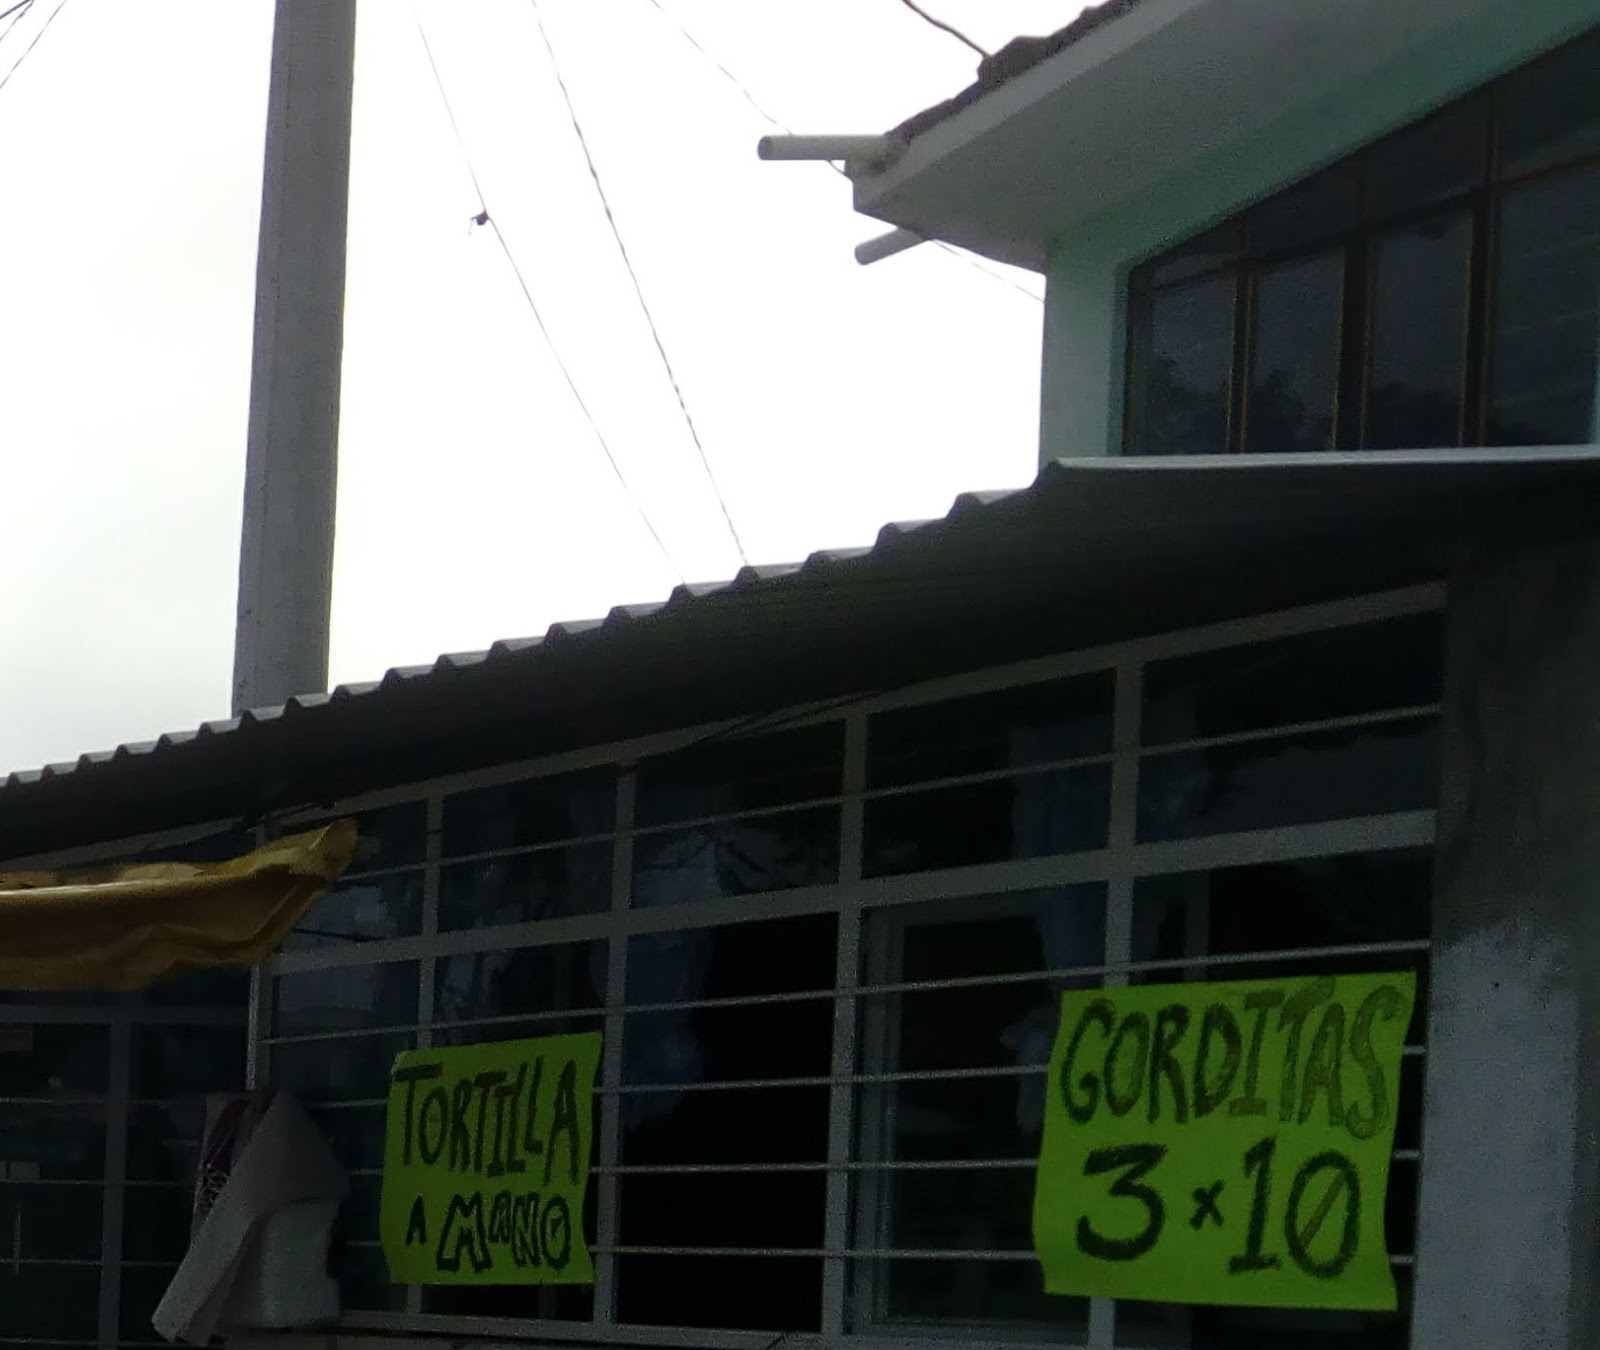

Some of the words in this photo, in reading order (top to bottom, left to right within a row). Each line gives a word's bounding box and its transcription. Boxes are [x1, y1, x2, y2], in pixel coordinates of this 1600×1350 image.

[393, 1055, 581, 1187] TORTILLA
[1060, 976, 1403, 1140] GORDITAS
[1075, 1143, 1166, 1261] 3
